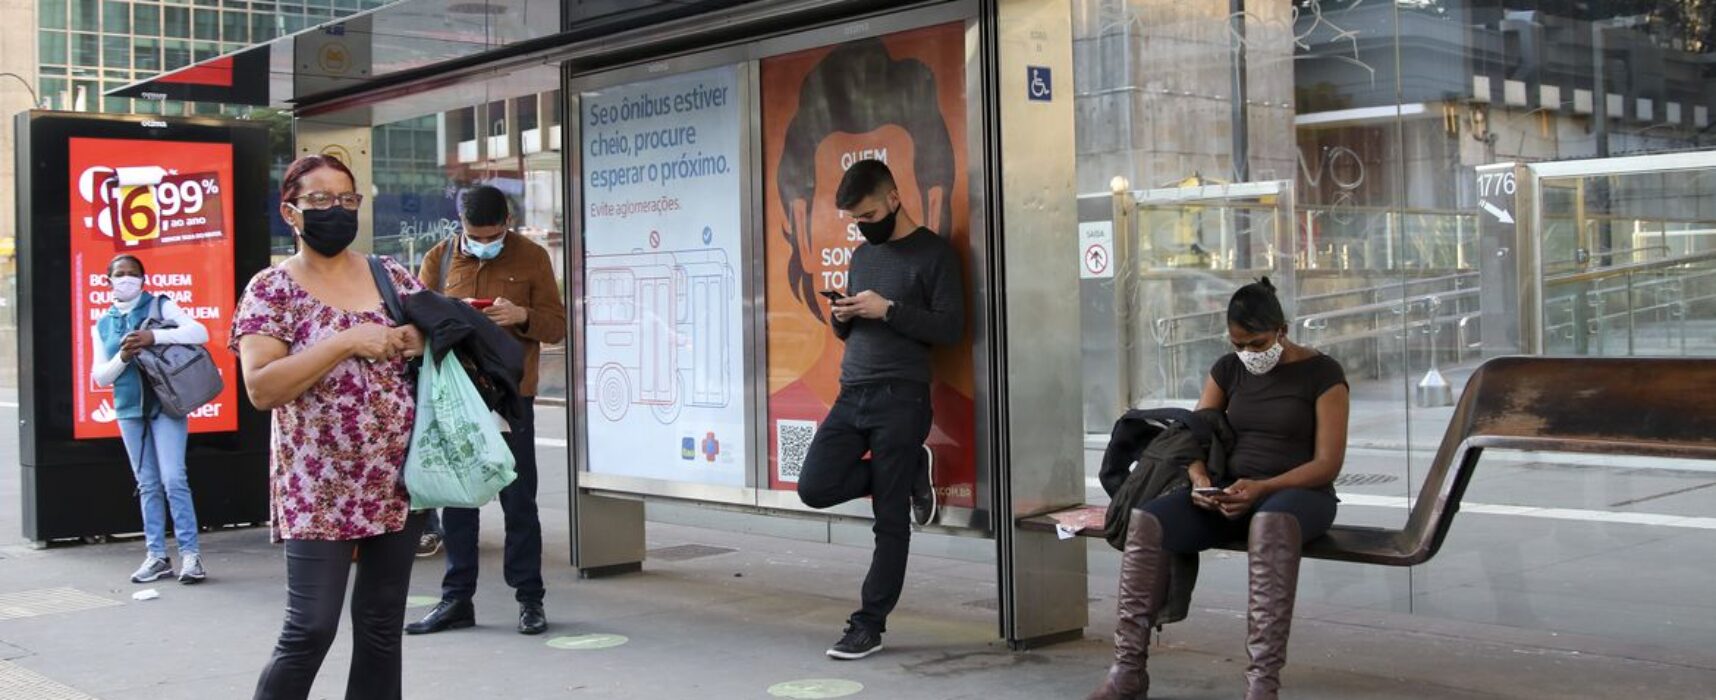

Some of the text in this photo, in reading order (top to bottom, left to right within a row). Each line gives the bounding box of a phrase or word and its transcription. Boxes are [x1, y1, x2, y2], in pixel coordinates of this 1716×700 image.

[590, 84, 729, 126] Se o ônibus estiver
[590, 125, 696, 157] cheio, procure
[590, 152, 731, 192] esperar o próximo.
[1477, 171, 1516, 197] 1776
[171, 217, 206, 227] ao ano
[590, 203, 614, 217] Evite
[152, 274, 192, 287] QUEM
